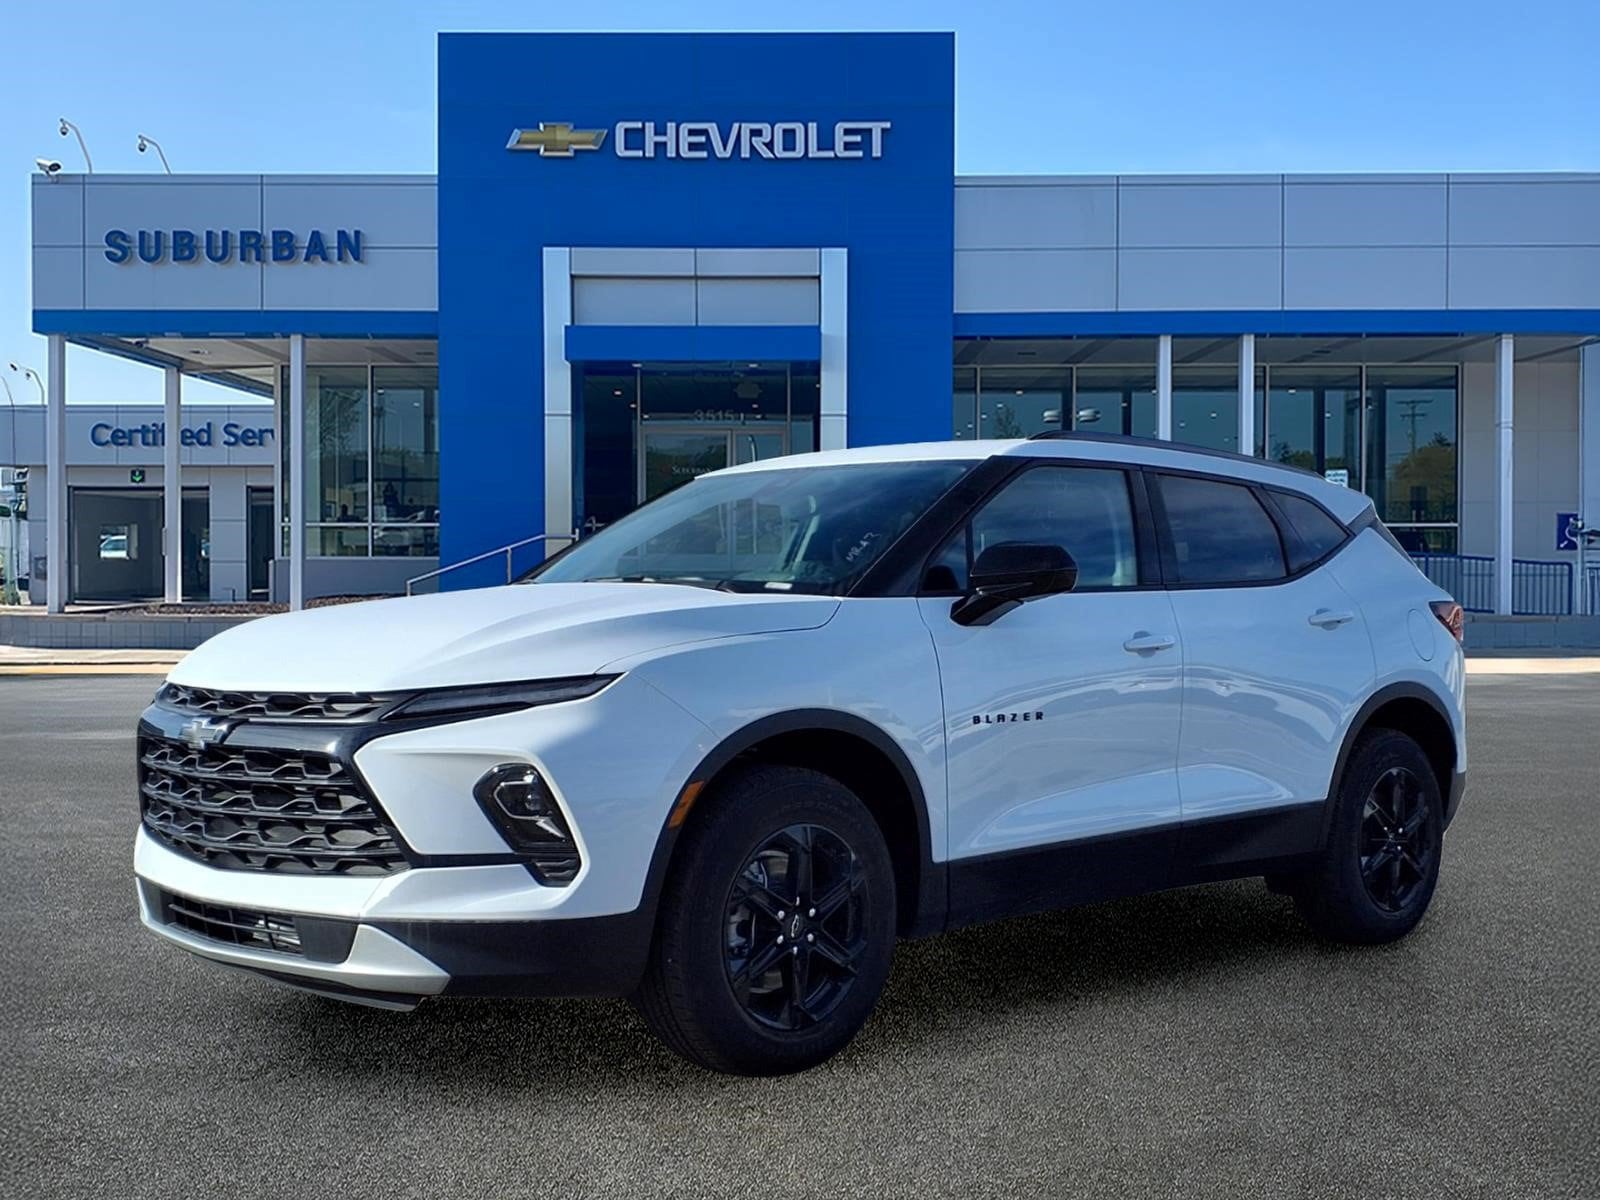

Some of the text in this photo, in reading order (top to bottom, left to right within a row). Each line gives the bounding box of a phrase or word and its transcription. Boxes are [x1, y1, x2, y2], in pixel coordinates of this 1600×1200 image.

[615, 121, 891, 158] CHEVROLET
[104, 229, 362, 263] SUBURBAN
[90, 421, 213, 447] Certifed
[972, 711, 1044, 725] BLAZER
